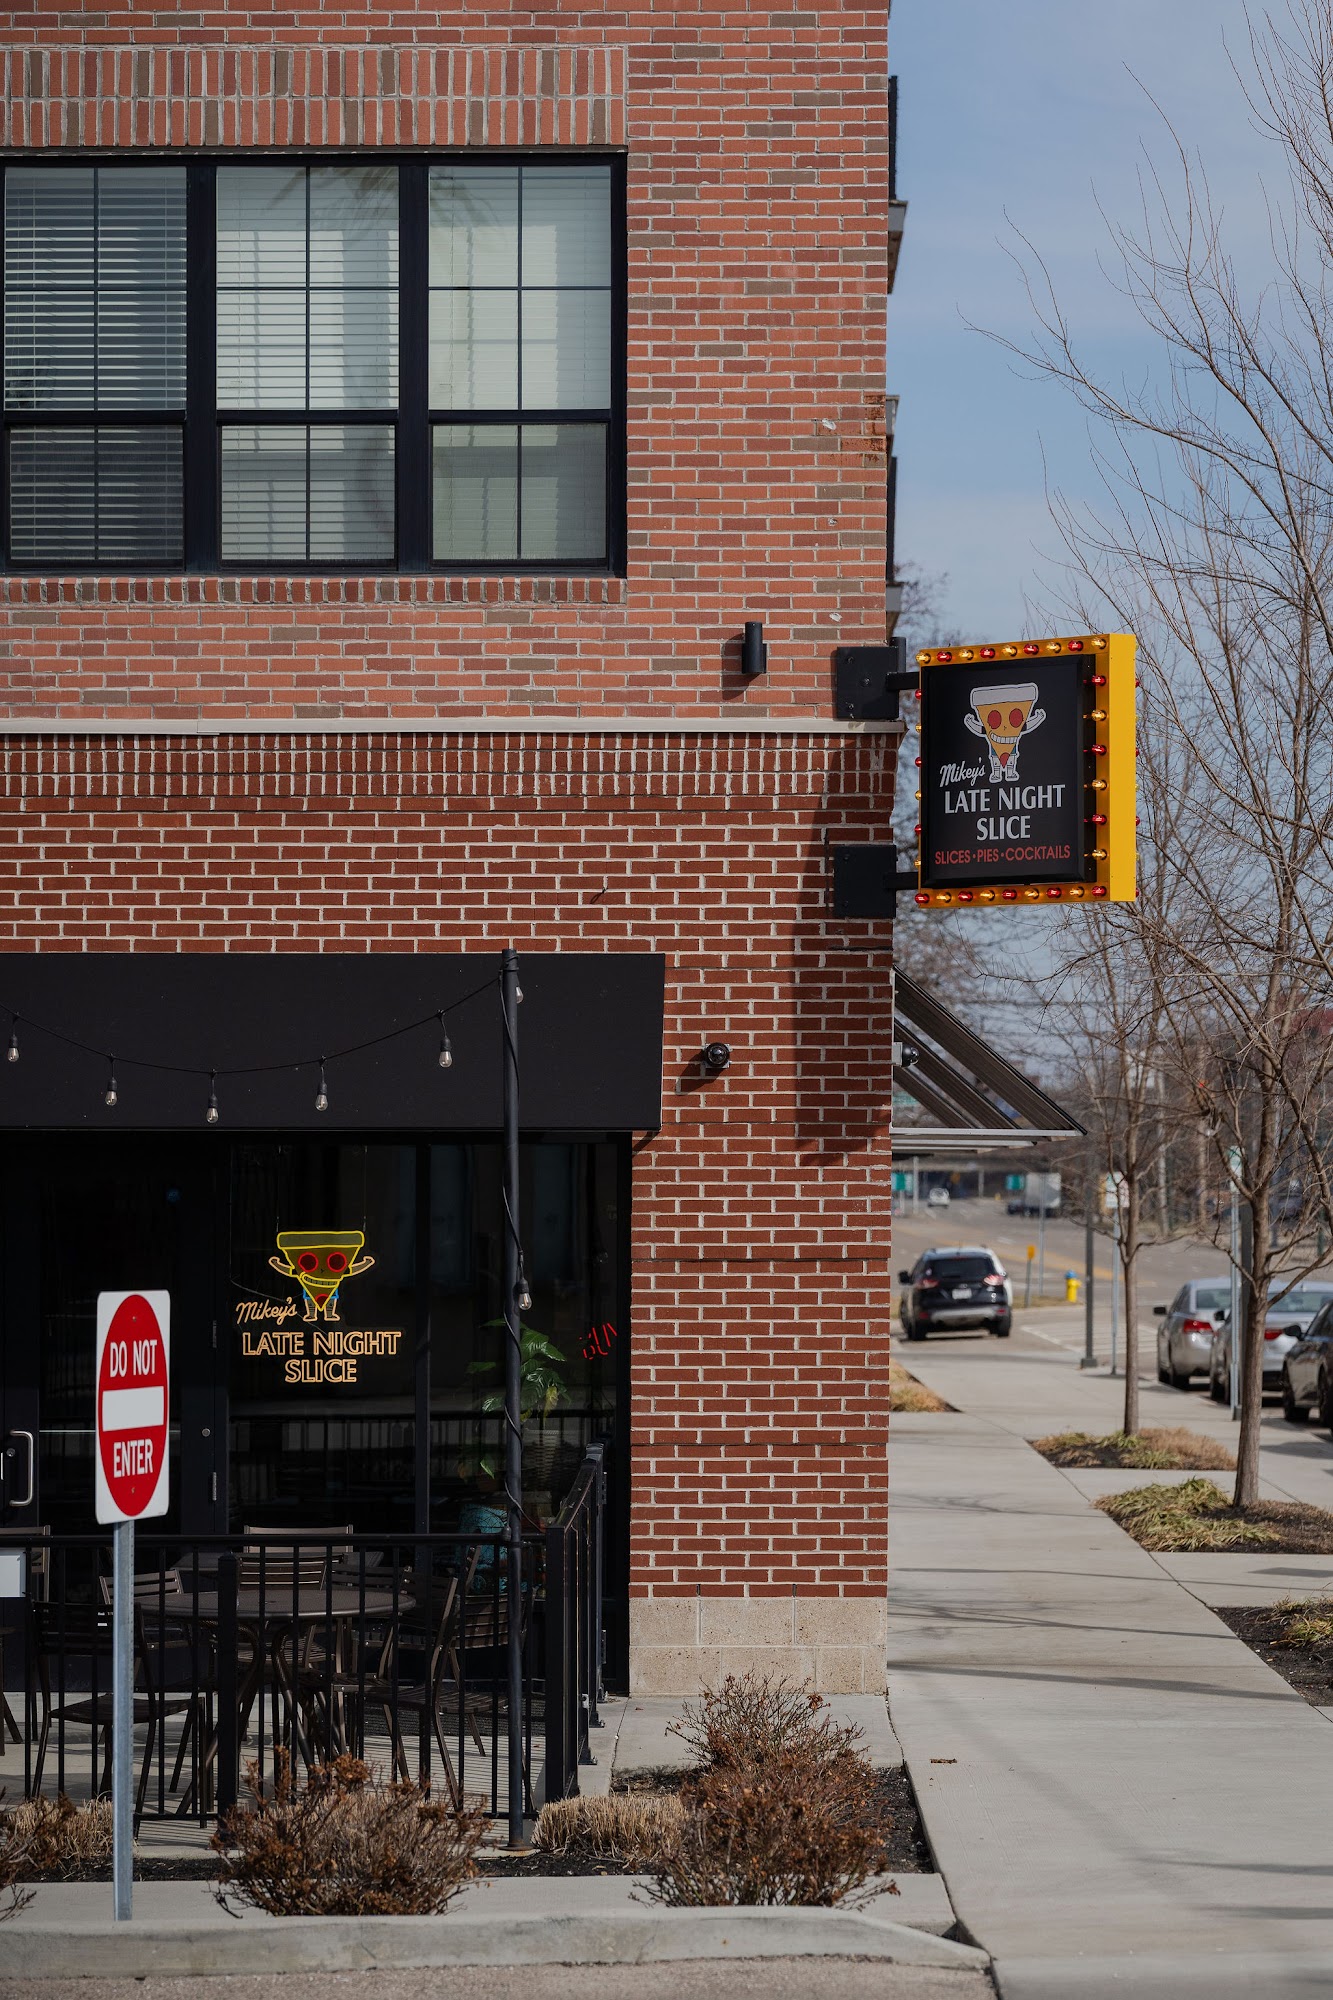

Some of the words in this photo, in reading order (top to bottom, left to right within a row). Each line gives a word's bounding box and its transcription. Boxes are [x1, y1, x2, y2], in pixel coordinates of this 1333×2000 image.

[939, 756, 985, 787] Mikey's
[944, 788, 990, 814] LATE
[998, 784, 1065, 811] NIGHT
[976, 815, 1031, 841] SLICE
[236, 1296, 297, 1325] Mikey's
[242, 1332, 304, 1355] LATE
[313, 1331, 402, 1355] NIGHT
[110, 1340, 127, 1378] DO
[132, 1339, 157, 1376] NOT
[285, 1358, 357, 1383] SLICE
[113, 1438, 154, 1478] ENTER
